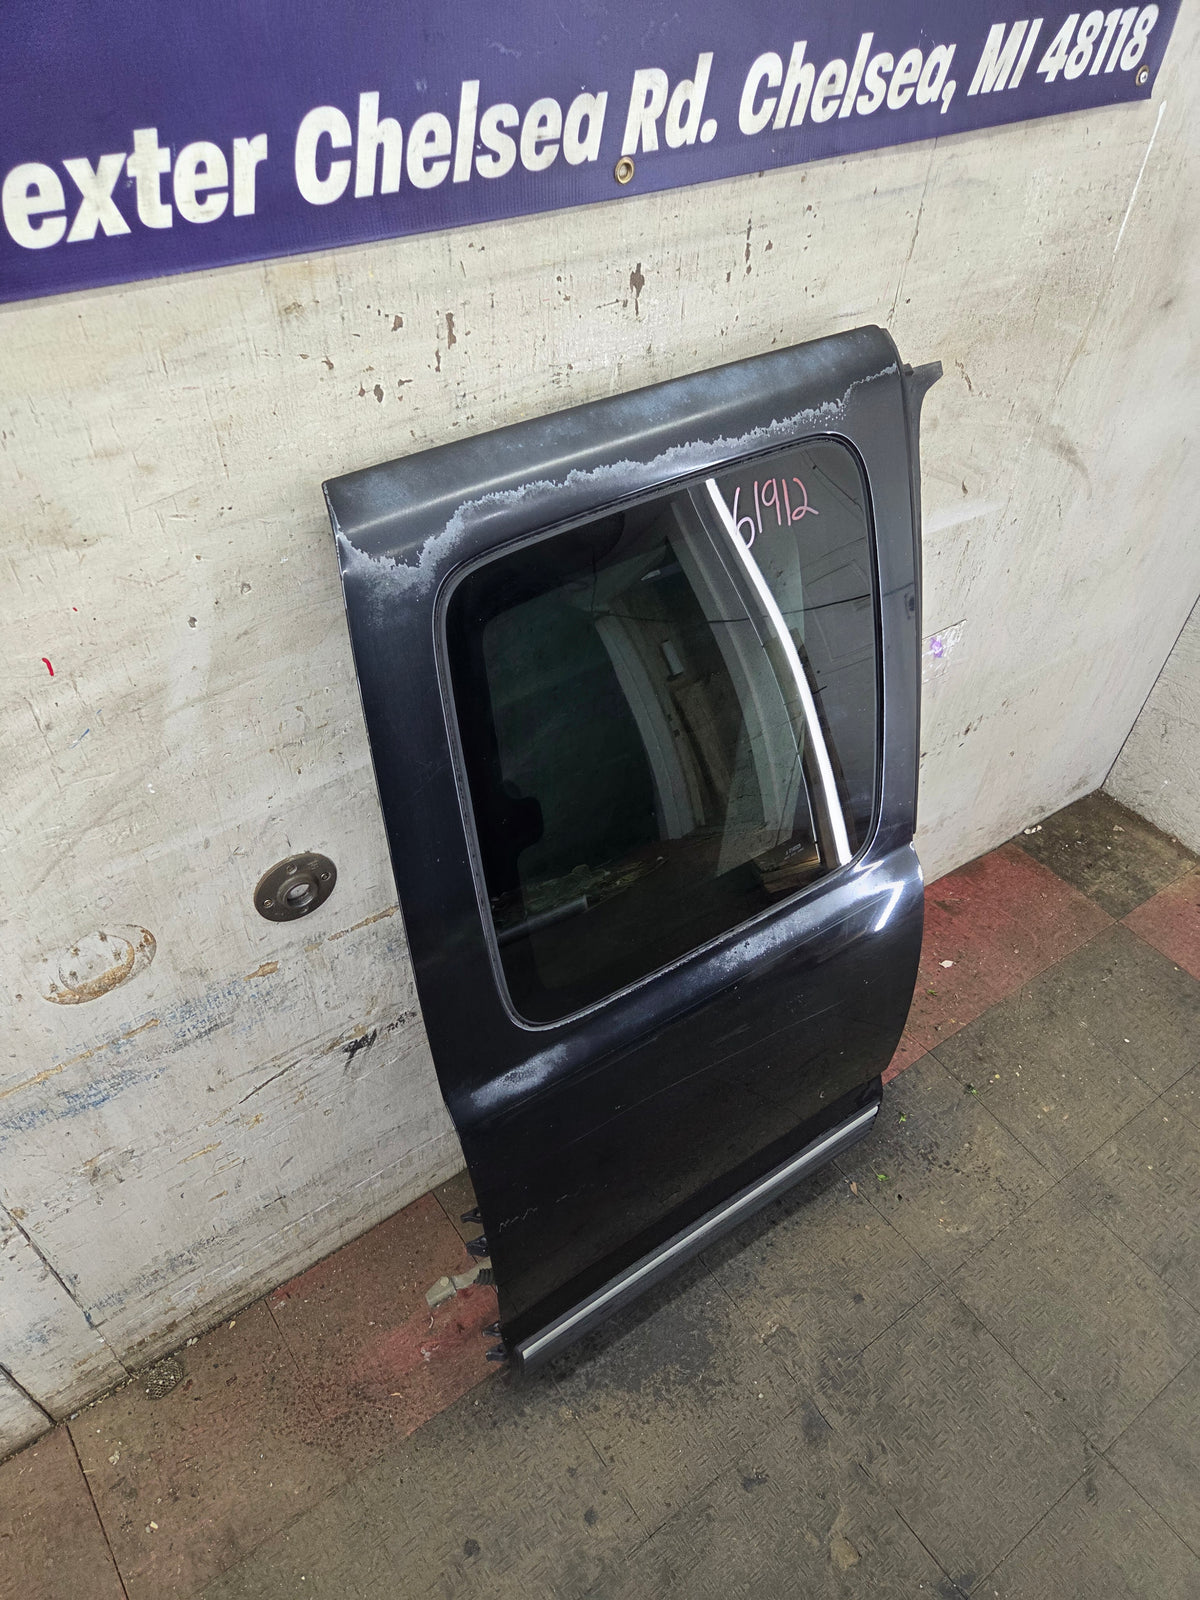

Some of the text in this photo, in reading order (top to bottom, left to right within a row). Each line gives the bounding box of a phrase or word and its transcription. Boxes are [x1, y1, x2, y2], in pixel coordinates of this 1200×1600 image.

[1, 4, 1160, 250] exter Chelsea Rd. Chelsea, MI 48118
[732, 476, 820, 550] 61912
